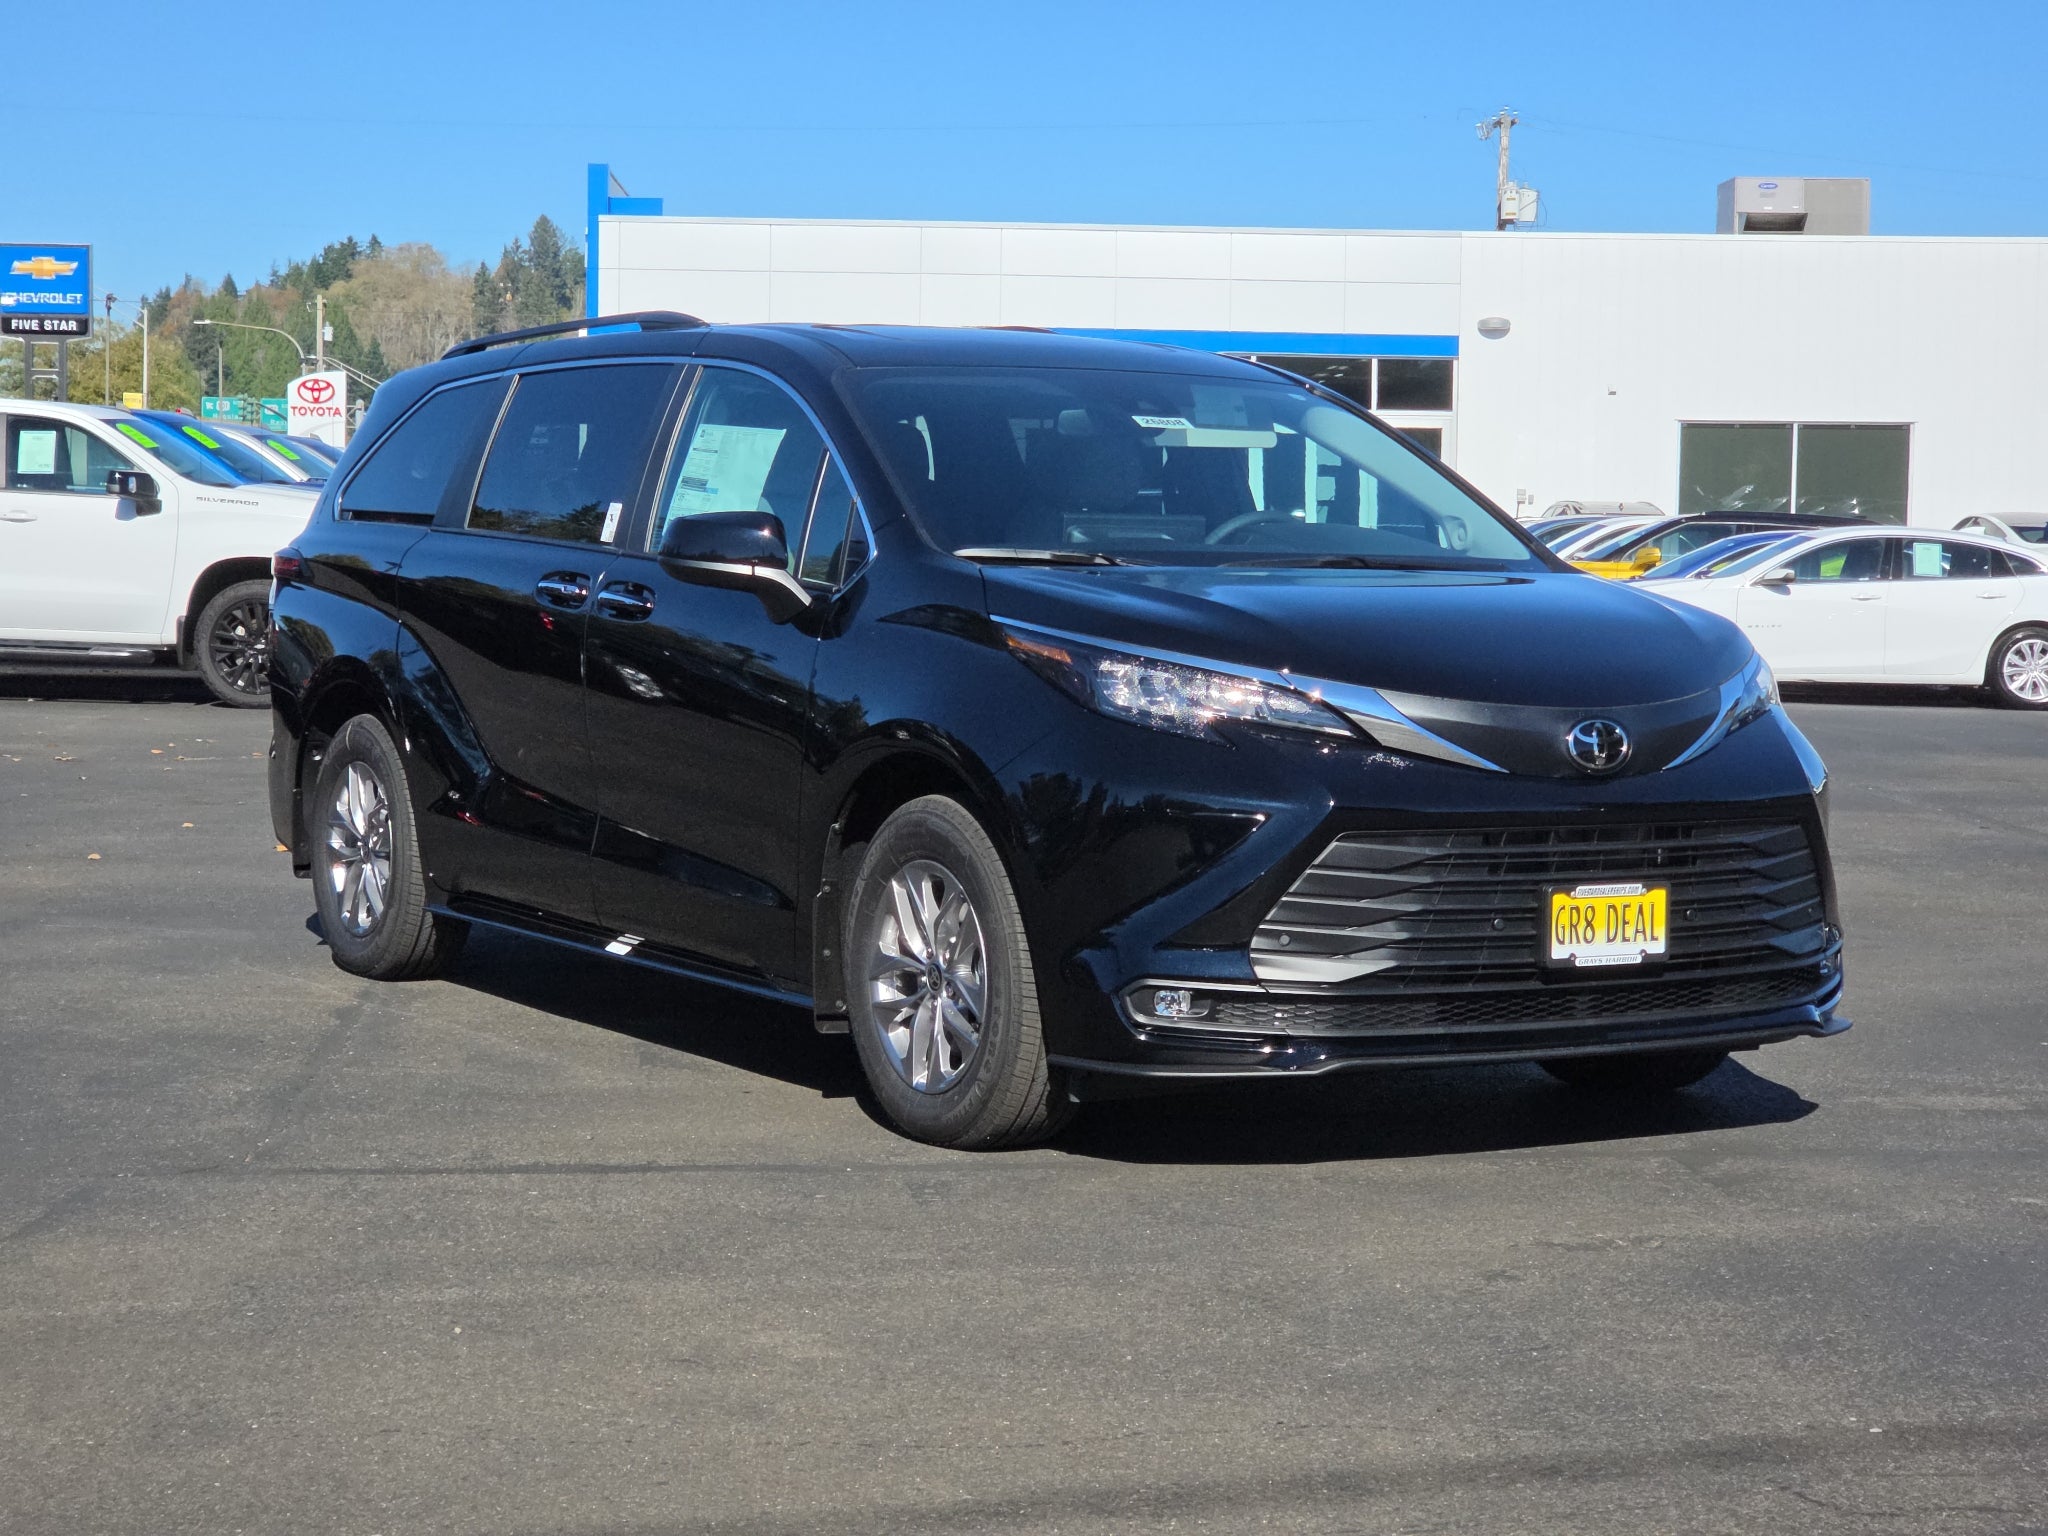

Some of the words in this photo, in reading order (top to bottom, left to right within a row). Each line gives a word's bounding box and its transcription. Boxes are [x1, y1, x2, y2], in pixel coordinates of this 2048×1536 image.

[11, 319, 40, 331] FIVE
[43, 320, 77, 331] STAR
[290, 406, 343, 417] TOYOTA
[196, 496, 259, 506] SILVERADO
[1555, 904, 1596, 946] GR8
[1606, 902, 1659, 944] DEAL
